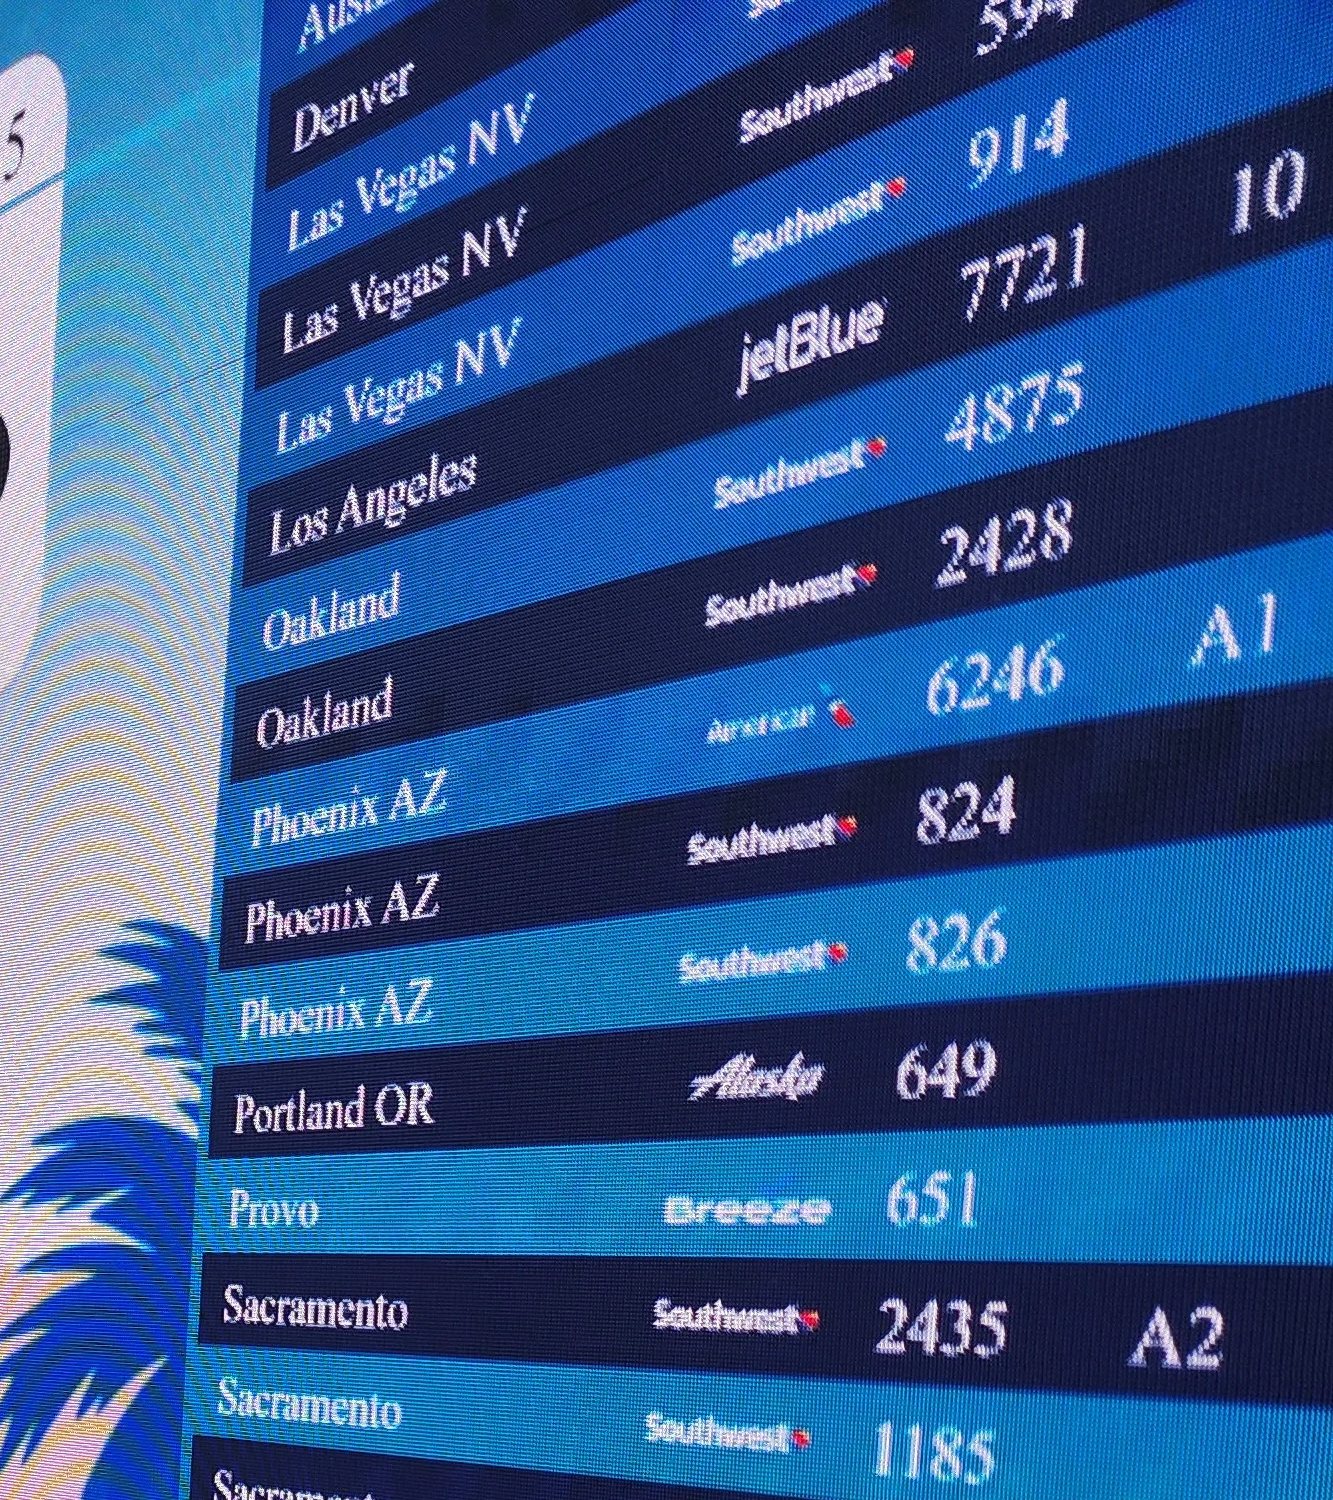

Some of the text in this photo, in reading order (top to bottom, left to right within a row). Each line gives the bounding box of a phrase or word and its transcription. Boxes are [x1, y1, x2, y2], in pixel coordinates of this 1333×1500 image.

[287, 91, 535, 251] Las Vegas NV
[291, 61, 415, 153] Denver
[277, 97, 1070, 454] Las Vegas NV Southwest 914
[284, 303, 338, 355] Las
[349, 254, 450, 321] Vegas
[461, 204, 528, 277] NV
[738, 49, 894, 145] Southwest
[269, 148, 1306, 557] Los Angeles jetBlue 7721 10
[262, 360, 1084, 651] Oakland Southwest 4875
[256, 497, 1073, 750] Oakland Southwest 2428
[250, 785, 381, 850] Phoenix
[387, 766, 449, 822] AZ
[926, 633, 1066, 716] 6246
[244, 774, 1016, 945] Phoenix AZ Southwest 824
[238, 906, 1007, 1042] Phoenix AZ Southwest 826
[233, 1083, 365, 1134] Portland
[374, 1081, 435, 1126] OR
[896, 1037, 998, 1101] 649
[229, 1169, 977, 1229] Provo Breeze 651
[223, 1284, 1225, 1371] Sacramento Southwest 2435 A2
[217, 1376, 996, 1487] Sacramento Southwest 1185
